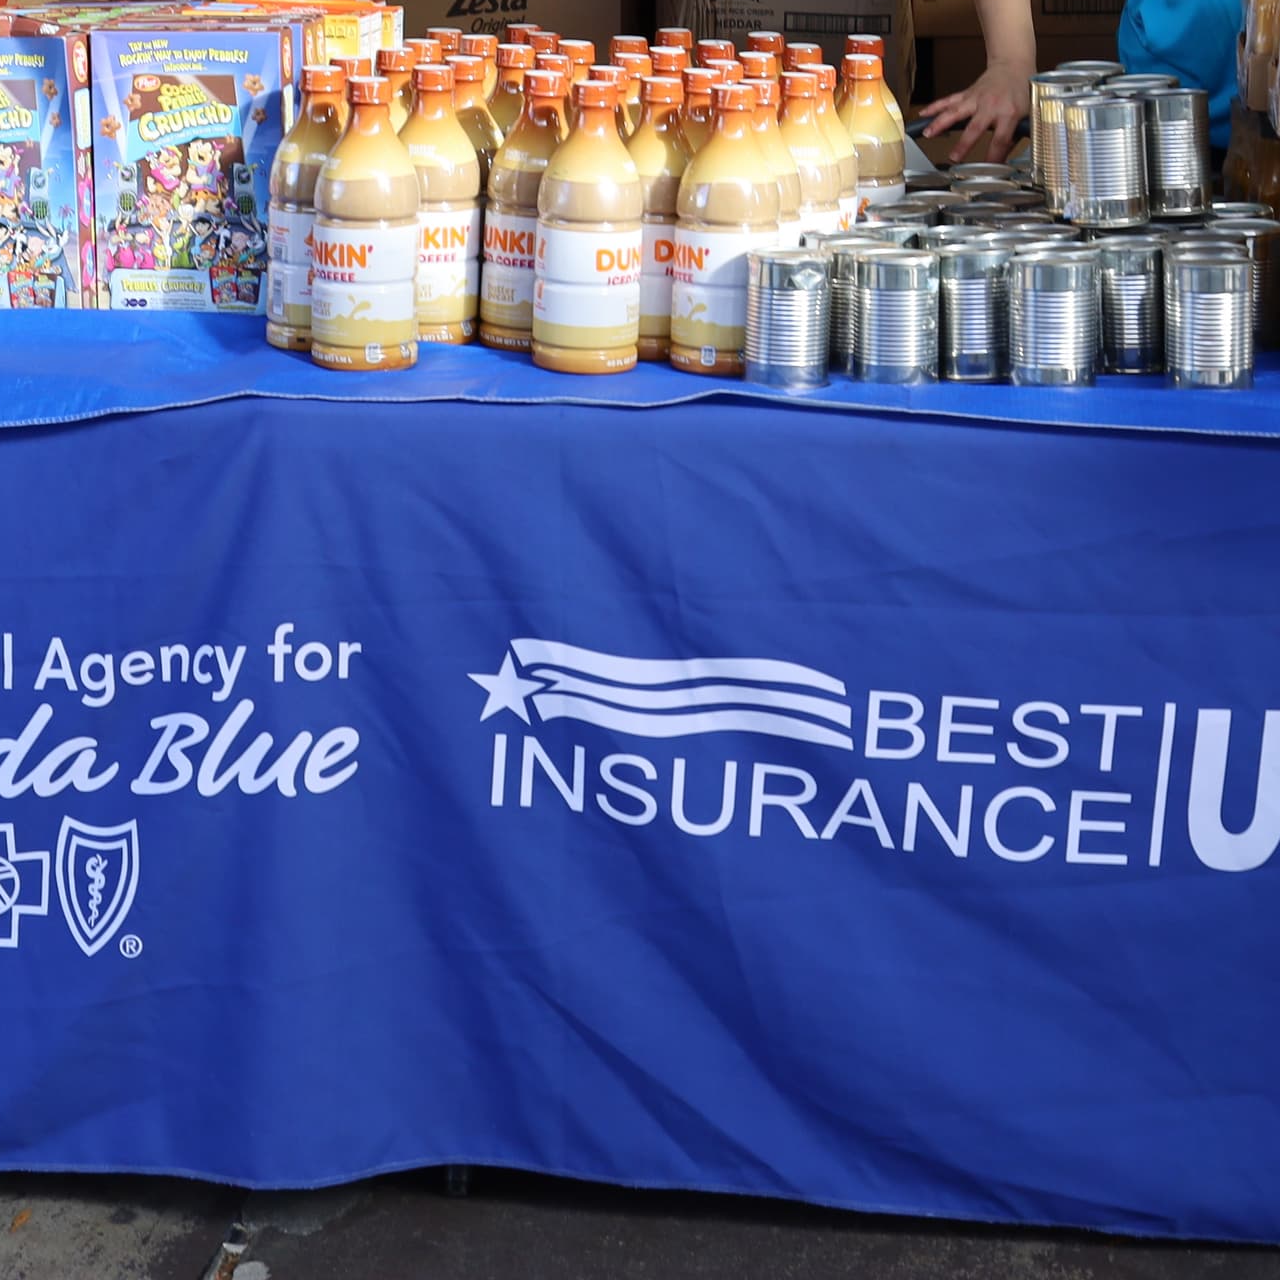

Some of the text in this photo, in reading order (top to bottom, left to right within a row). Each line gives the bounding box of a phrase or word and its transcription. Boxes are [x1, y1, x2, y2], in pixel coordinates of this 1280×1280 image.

[128, 39, 168, 52] TRY NEW
[153, 50, 172, 62] WAY
[32, 635, 247, 708] Agency
[267, 622, 363, 684] for
[129, 698, 361, 798] Blue
[864, 689, 1144, 773] BEST
[489, 732, 1133, 866] INSURANCE
